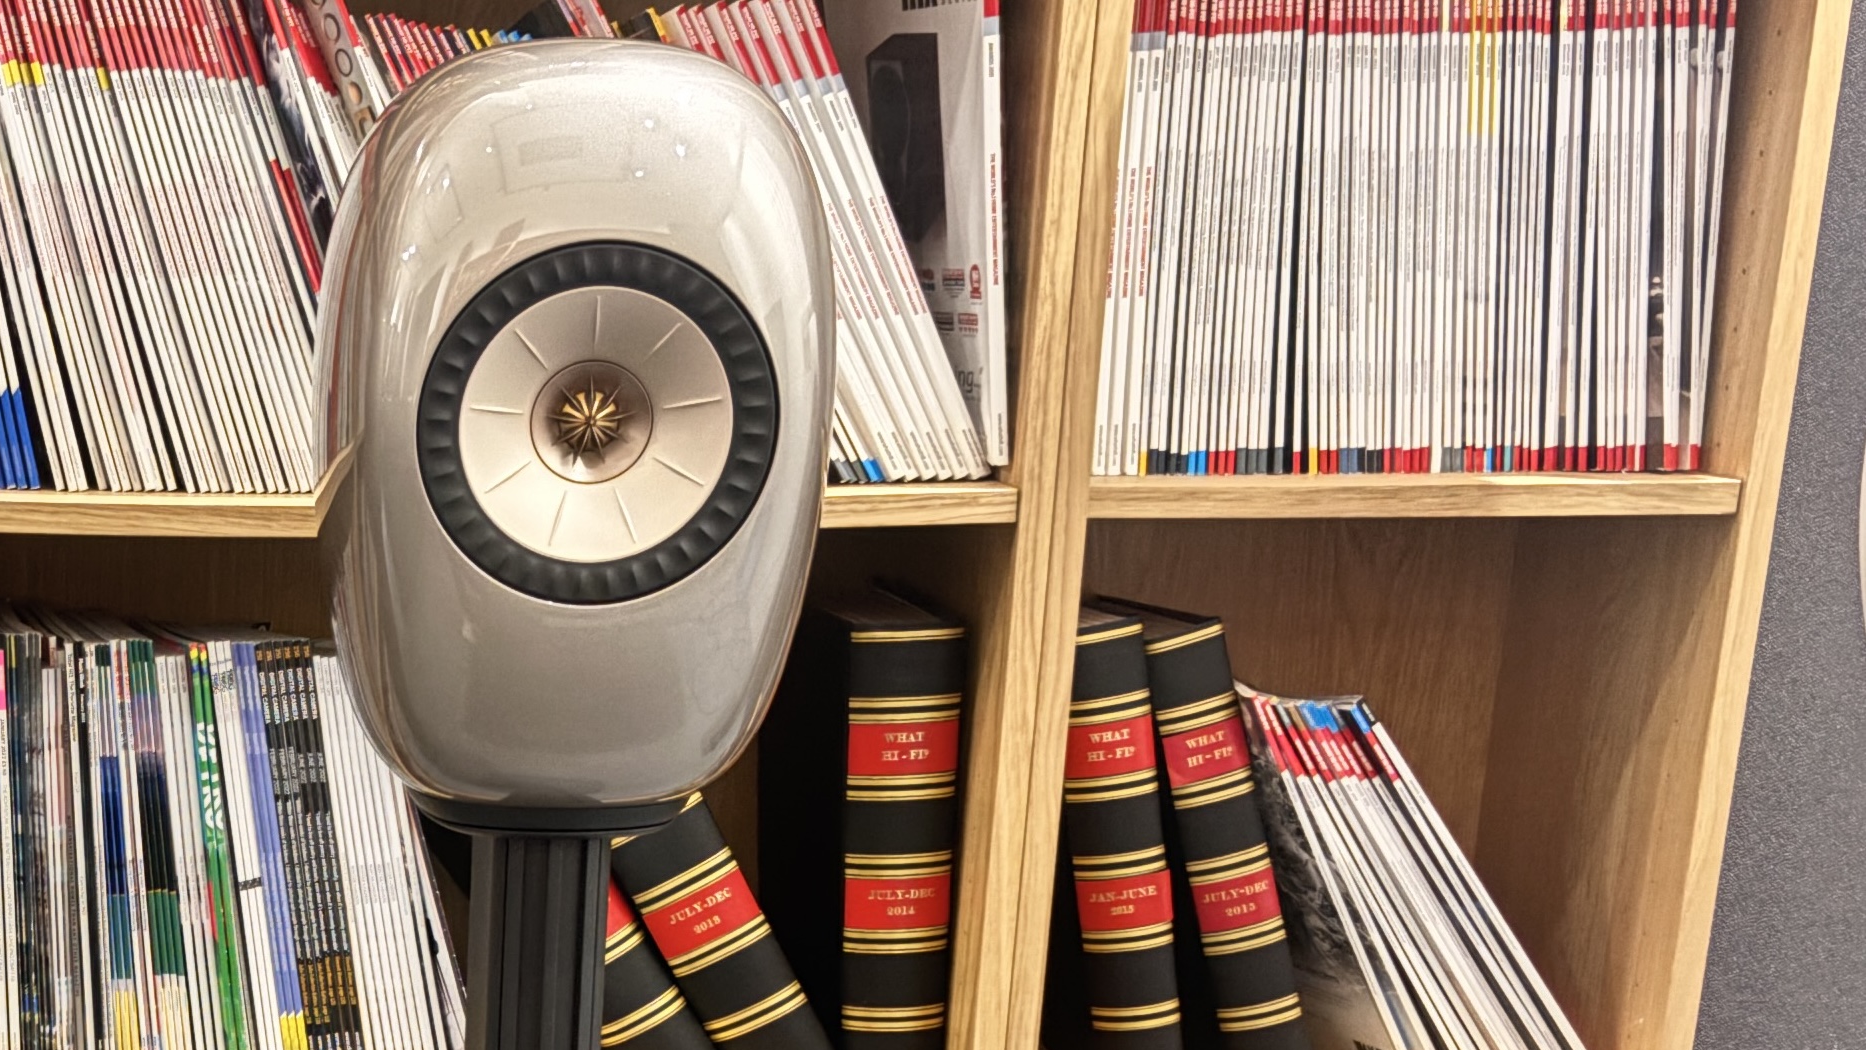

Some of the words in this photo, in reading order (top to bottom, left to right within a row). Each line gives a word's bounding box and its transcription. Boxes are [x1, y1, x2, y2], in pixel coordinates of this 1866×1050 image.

[258, 671, 267, 696] DIGITAL
[268, 672, 276, 695] DIGITAL
[277, 670, 285, 693] DIGITAL
[286, 668, 294, 692] DIGITAL
[296, 667, 304, 691] DIGITAL
[306, 667, 314, 691] DIGITAL
[261, 697, 270, 724] CAMERA
[271, 697, 280, 724] CAMERA
[280, 695, 289, 722] CAMERA
[289, 693, 298, 720] CAMERA
[299, 692, 307, 719] CAMERA
[309, 692, 317, 719] CAMERA
[884, 732, 925, 743] WHAT
[1088, 728, 1130, 744] WHAT
[1185, 731, 1225, 749] WHAT
[868, 888, 936, 900] JULY-DEC
[1089, 885, 1157, 903] JAN-JUNE
[1203, 880, 1269, 904] JULY-DEC
[670, 887, 732, 925] JULY-DEC
[887, 906, 915, 916] 2014
[1225, 903, 1256, 917] 2015
